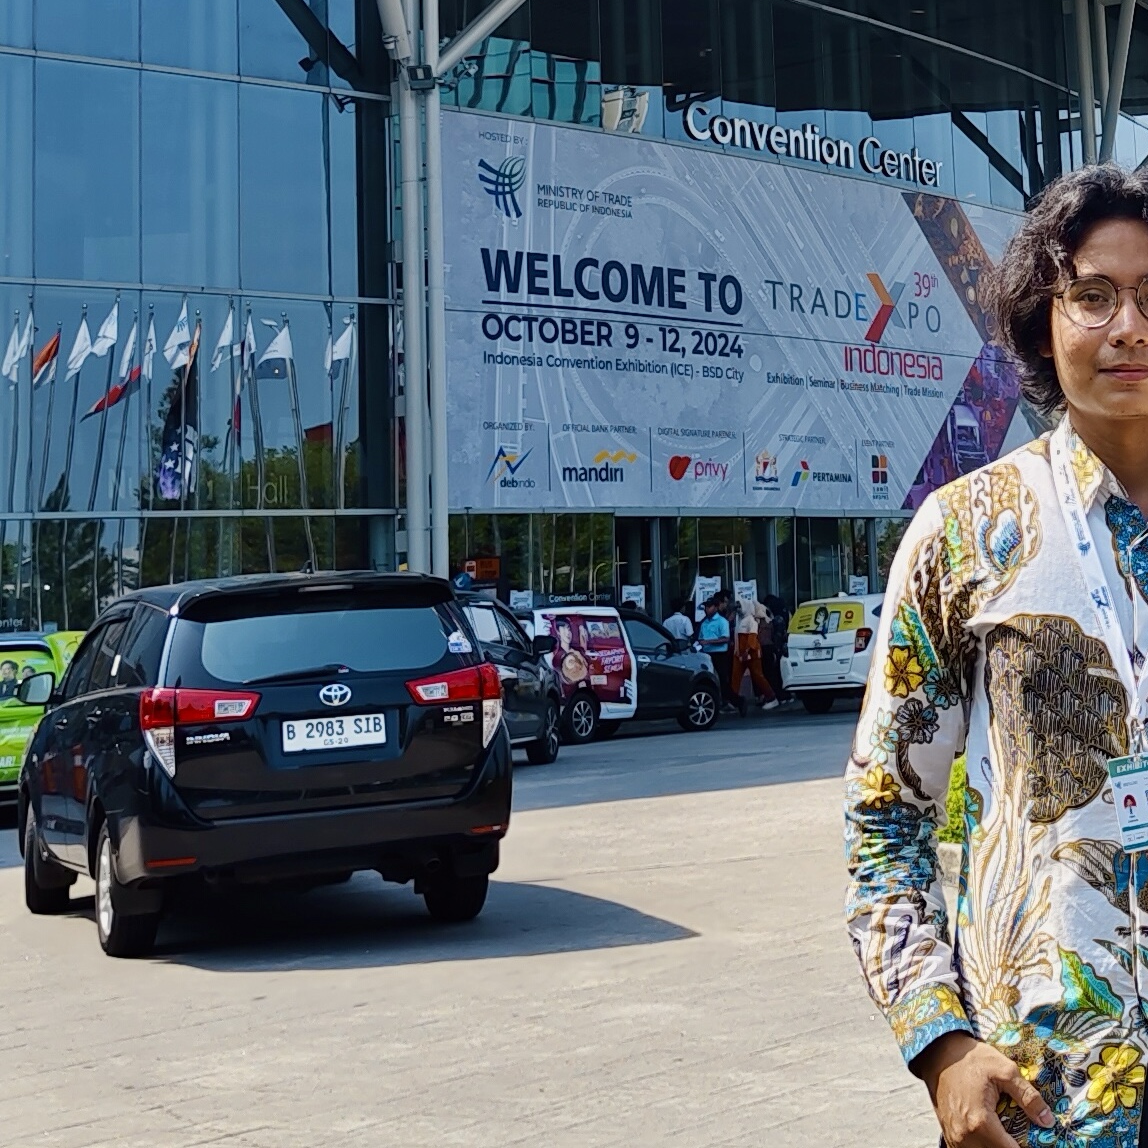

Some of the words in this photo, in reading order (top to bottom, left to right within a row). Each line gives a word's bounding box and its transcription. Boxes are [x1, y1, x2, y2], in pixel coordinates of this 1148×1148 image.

[478, 131, 511, 143] HOSTED
[684, 102, 855, 169] Convention
[860, 135, 943, 187] Center
[537, 183, 584, 199] MINISTRY
[586, 189, 600, 202] OF
[602, 191, 633, 207] TRADE
[537, 198, 578, 212] REPUBLIC
[579, 202, 590, 213] OF
[591, 205, 633, 219] INDONESIA
[480, 247, 688, 310] WELCOME
[698, 271, 743, 316] TO
[481, 313, 613, 348] OCTOBER
[624, 323, 640, 349] 9
[691, 330, 744, 359] 2024
[483, 351, 543, 367] Indonesia
[546, 354, 613, 371] Convention
[615, 358, 668, 375] Exhibition
[670, 363, 694, 380] (ICE)
[702, 365, 724, 379] BSD
[726, 367, 745, 384] City
[766, 372, 805, 386] Exhibition
[809, 376, 836, 389] Seminar
[903, 386, 921, 397] Trade
[922, 387, 944, 399] Mission
[562, 462, 624, 483] mandiri
[694, 458, 729, 481] privy
[812, 471, 853, 484] PERTAMINA
[286, 724, 296, 740] B
[305, 719, 345, 739] 2983
[353, 716, 383, 734] SIB
